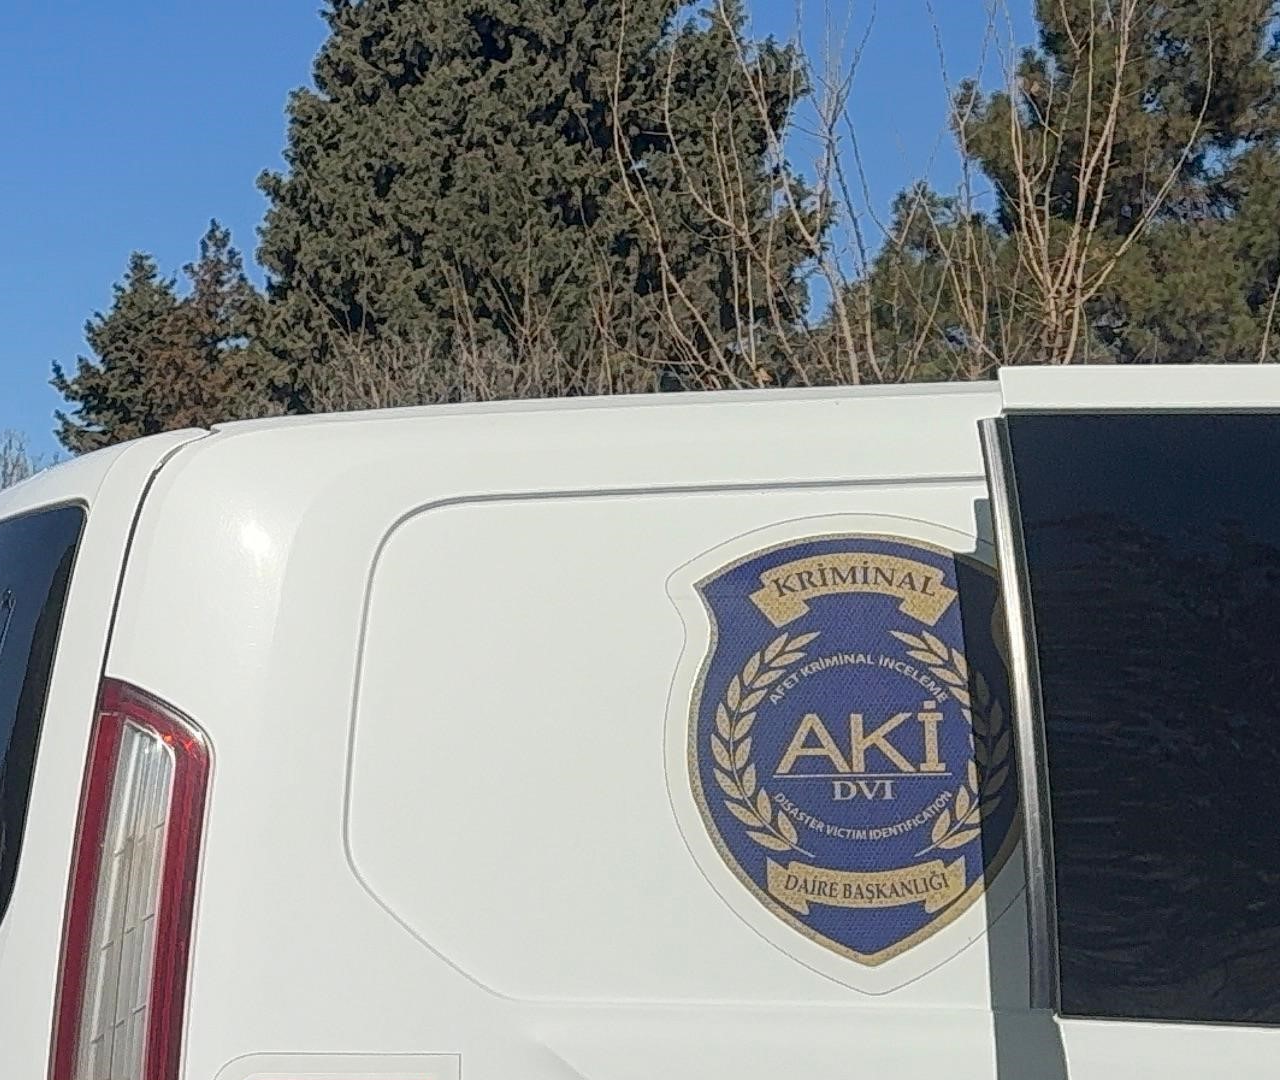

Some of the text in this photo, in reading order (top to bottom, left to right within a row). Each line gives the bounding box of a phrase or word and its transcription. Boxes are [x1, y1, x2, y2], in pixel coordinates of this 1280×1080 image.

[771, 560, 936, 597] KRİMİNAL
[769, 674, 800, 705] AFET
[777, 700, 947, 773] AKİ
[831, 780, 897, 800] DVI
[773, 791, 953, 840] DISASTER VICTIM IDENTIFICATION
[784, 870, 950, 903] DAİRE BAŞKANLIĞI
